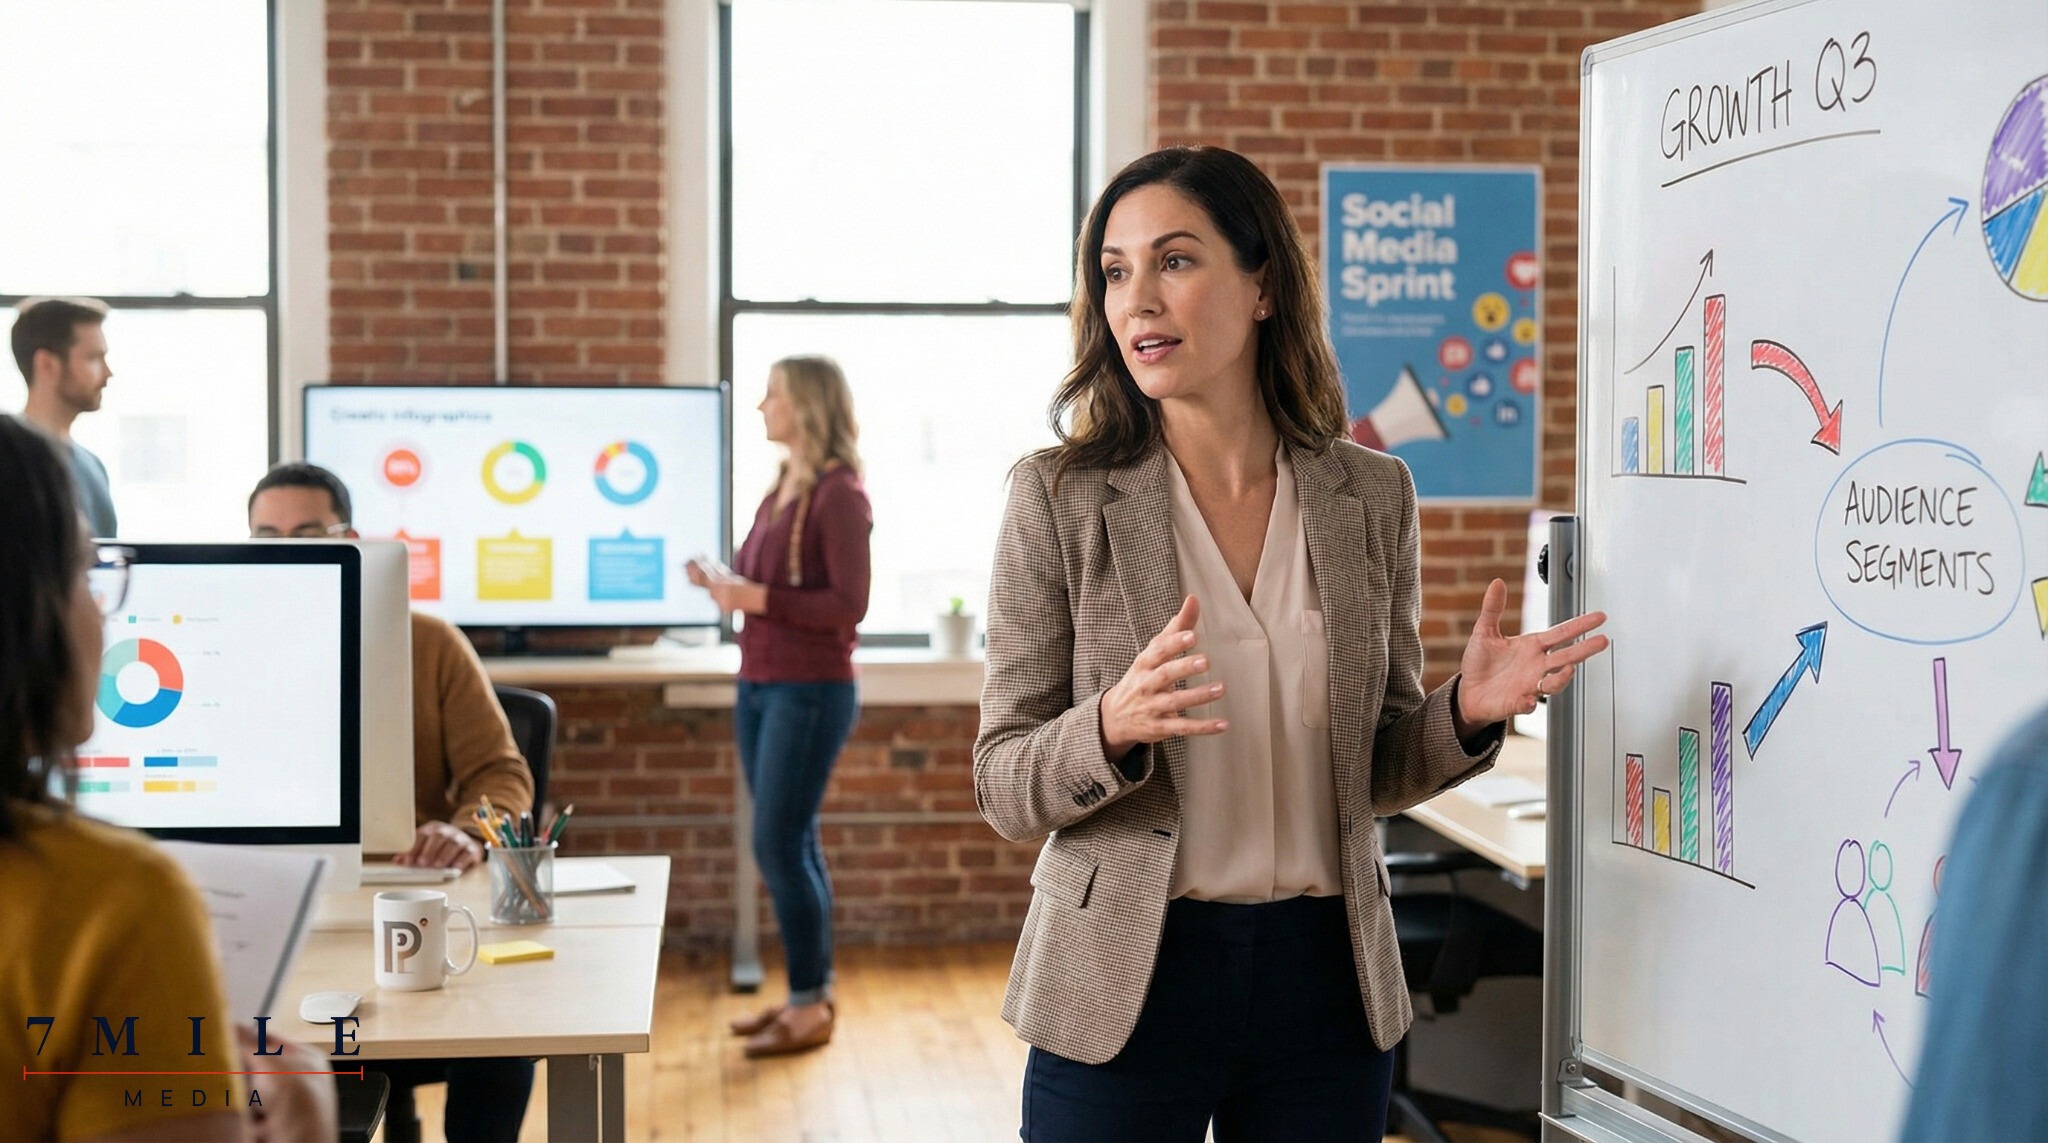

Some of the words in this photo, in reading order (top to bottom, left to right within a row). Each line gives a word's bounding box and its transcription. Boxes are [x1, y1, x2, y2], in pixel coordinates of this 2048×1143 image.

[1660, 59, 1792, 161] GROWTH
[1815, 31, 1877, 112] Q3
[1341, 193, 1455, 228] Social
[1342, 230, 1457, 265] Media
[1341, 265, 1456, 307] Sprint
[1844, 480, 1978, 526] AUDIENCE
[1845, 540, 1995, 595] SEGMENTS
